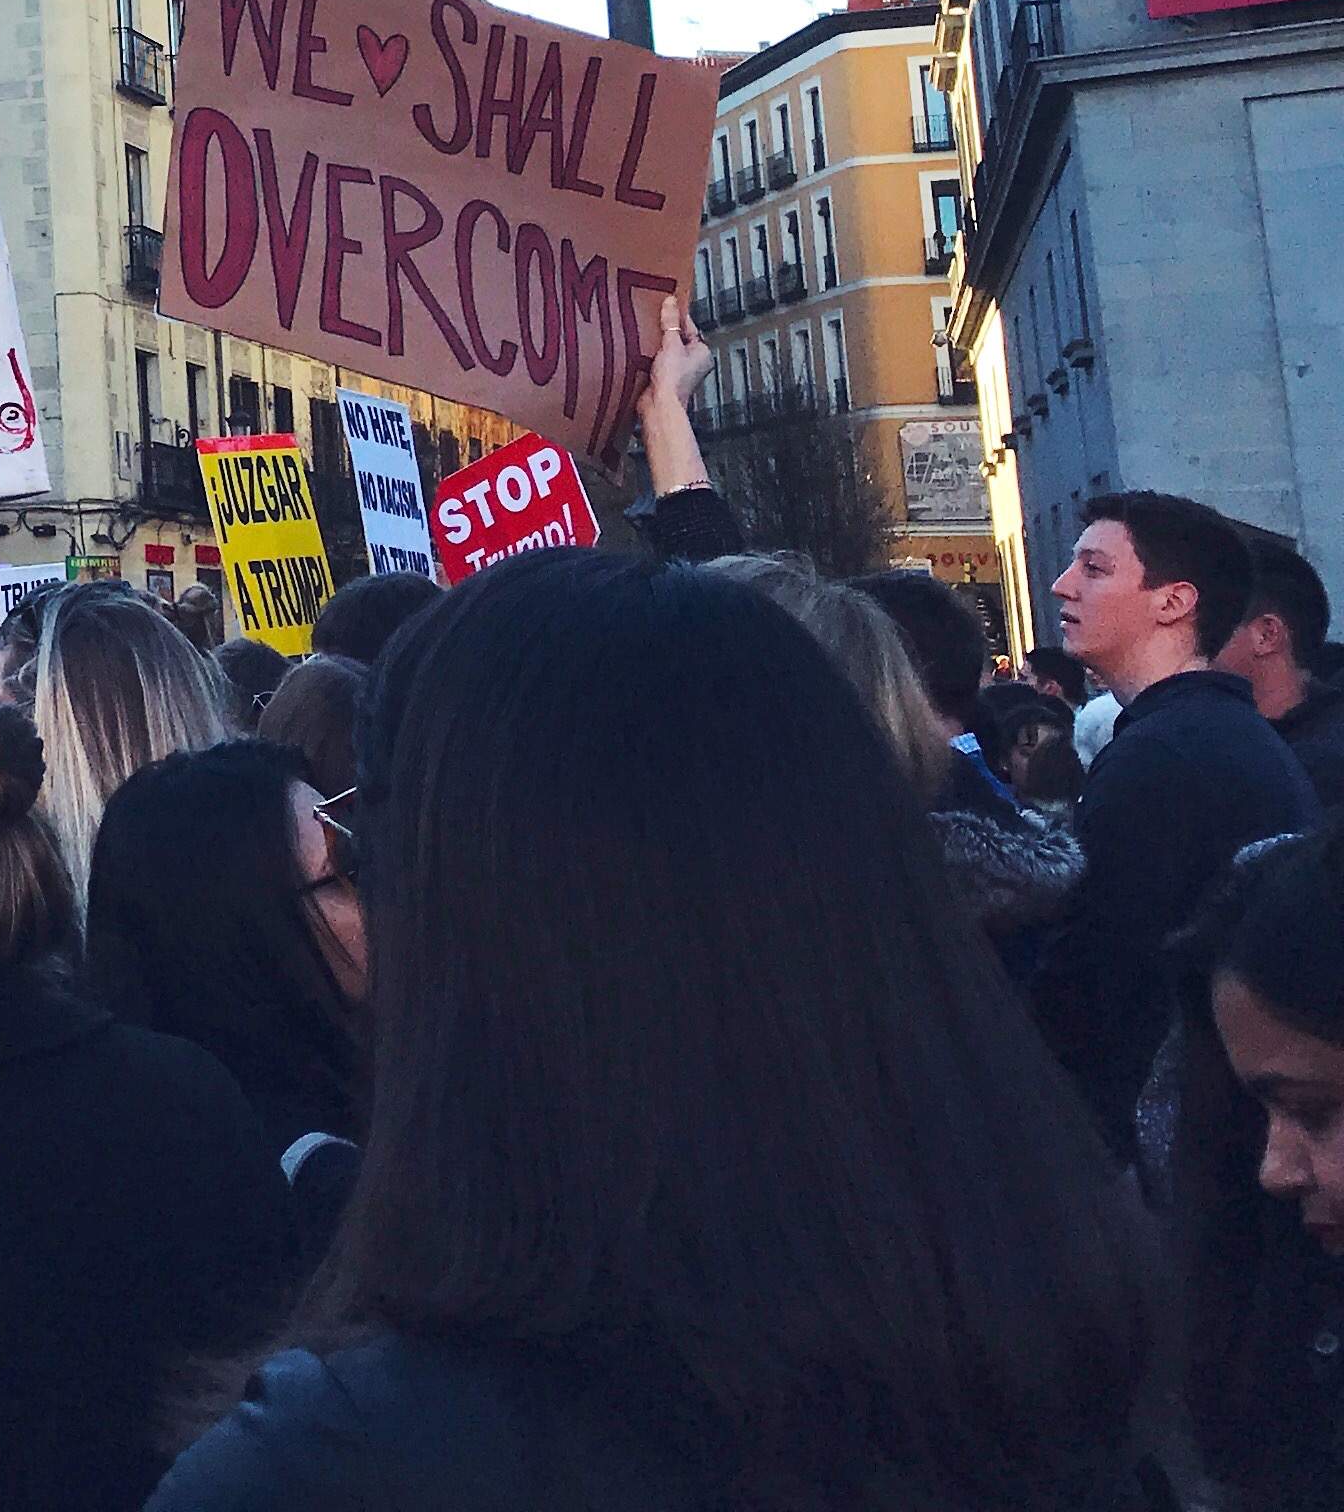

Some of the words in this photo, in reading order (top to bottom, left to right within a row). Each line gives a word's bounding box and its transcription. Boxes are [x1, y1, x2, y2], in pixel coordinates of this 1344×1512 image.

[179, 107, 678, 469] OVERCOME
[343, 399, 369, 441] NO
[367, 405, 413, 460] HATE,
[210, 454, 312, 544] ¡JUZGAR
[358, 470, 378, 511] NO
[438, 447, 561, 545] STOP
[234, 561, 261, 631] A
[248, 555, 331, 629] TRUMP!
